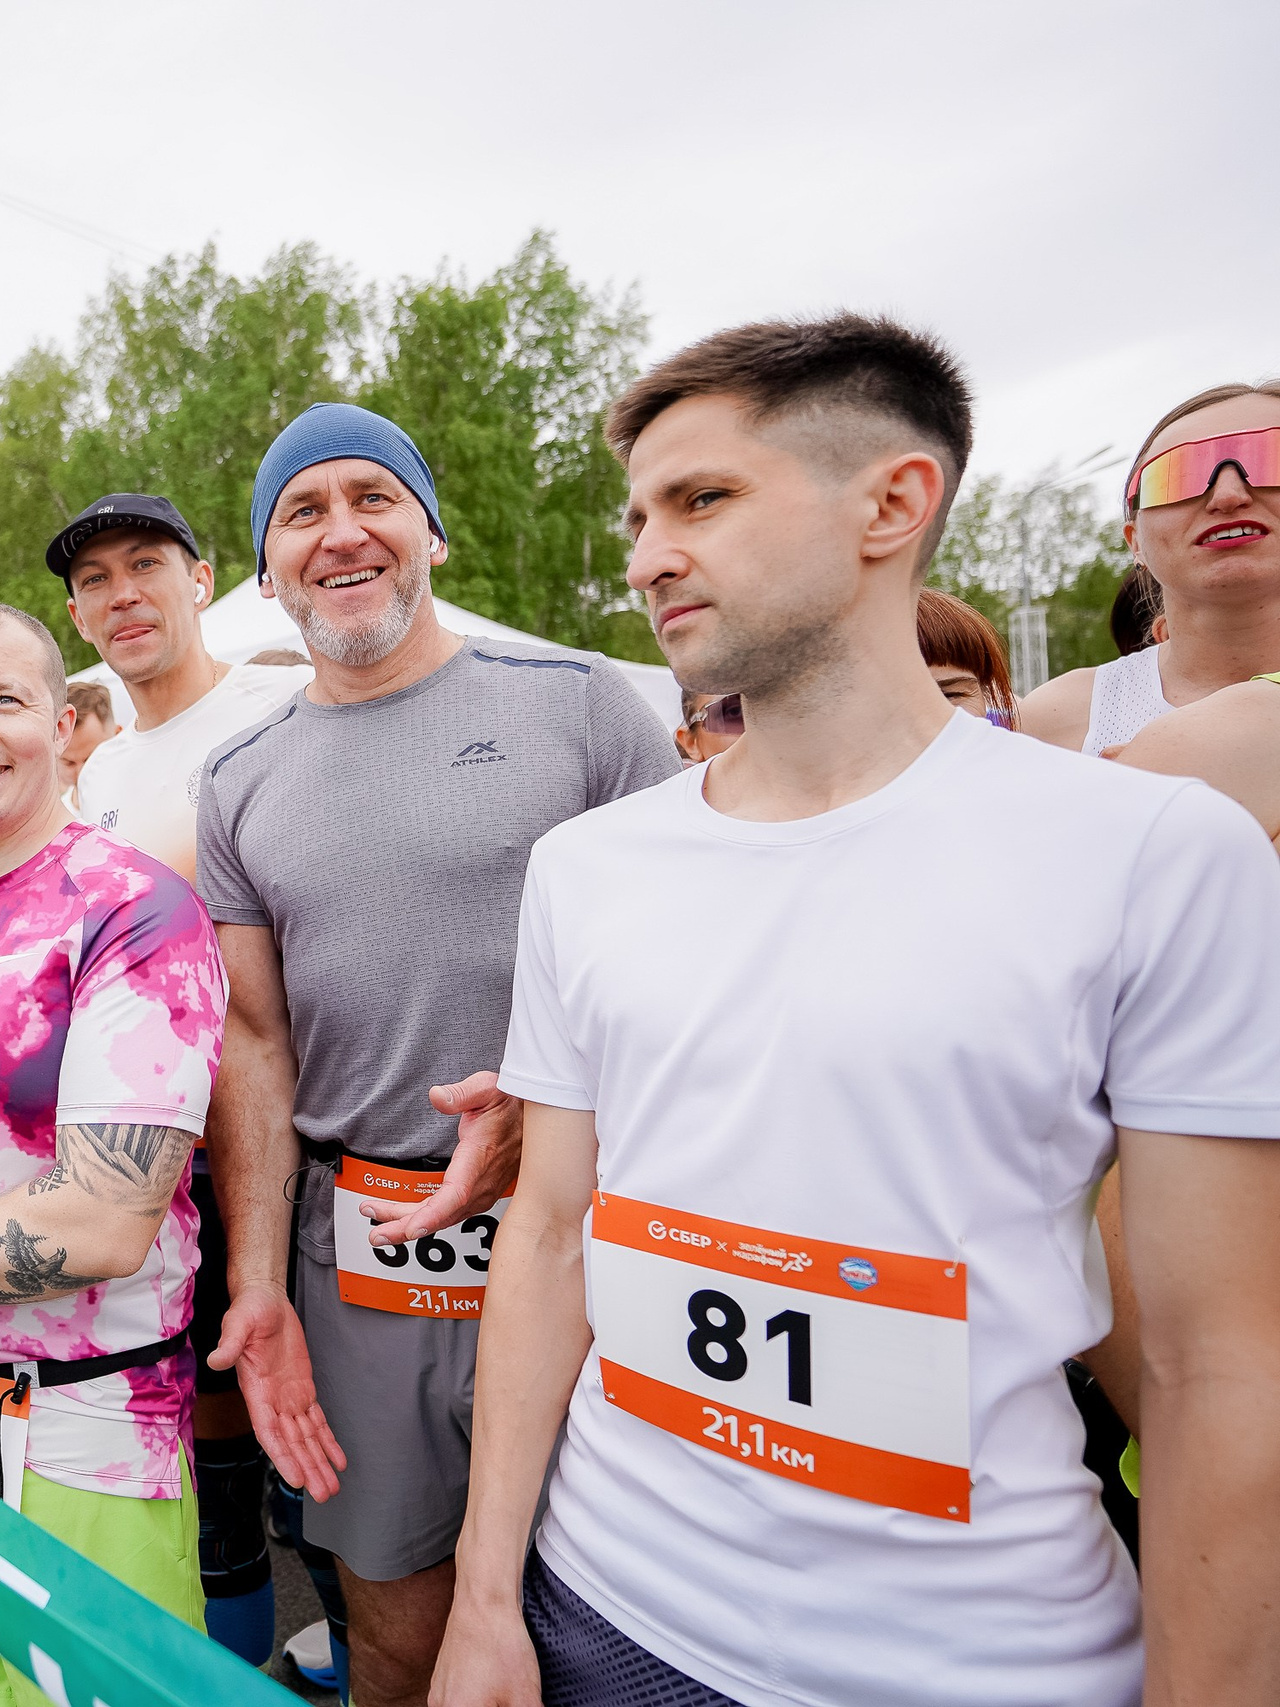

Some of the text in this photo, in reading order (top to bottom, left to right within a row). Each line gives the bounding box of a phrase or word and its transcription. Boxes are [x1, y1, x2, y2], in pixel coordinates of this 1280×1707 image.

[450, 754, 507, 768] ATHLEX
[374, 1177, 401, 1189] СБЕР
[669, 1227, 712, 1249] СБЕР
[407, 1288, 450, 1313] 21,1
[687, 1289, 813, 1407] 81
[701, 1406, 765, 1458] 21,1
